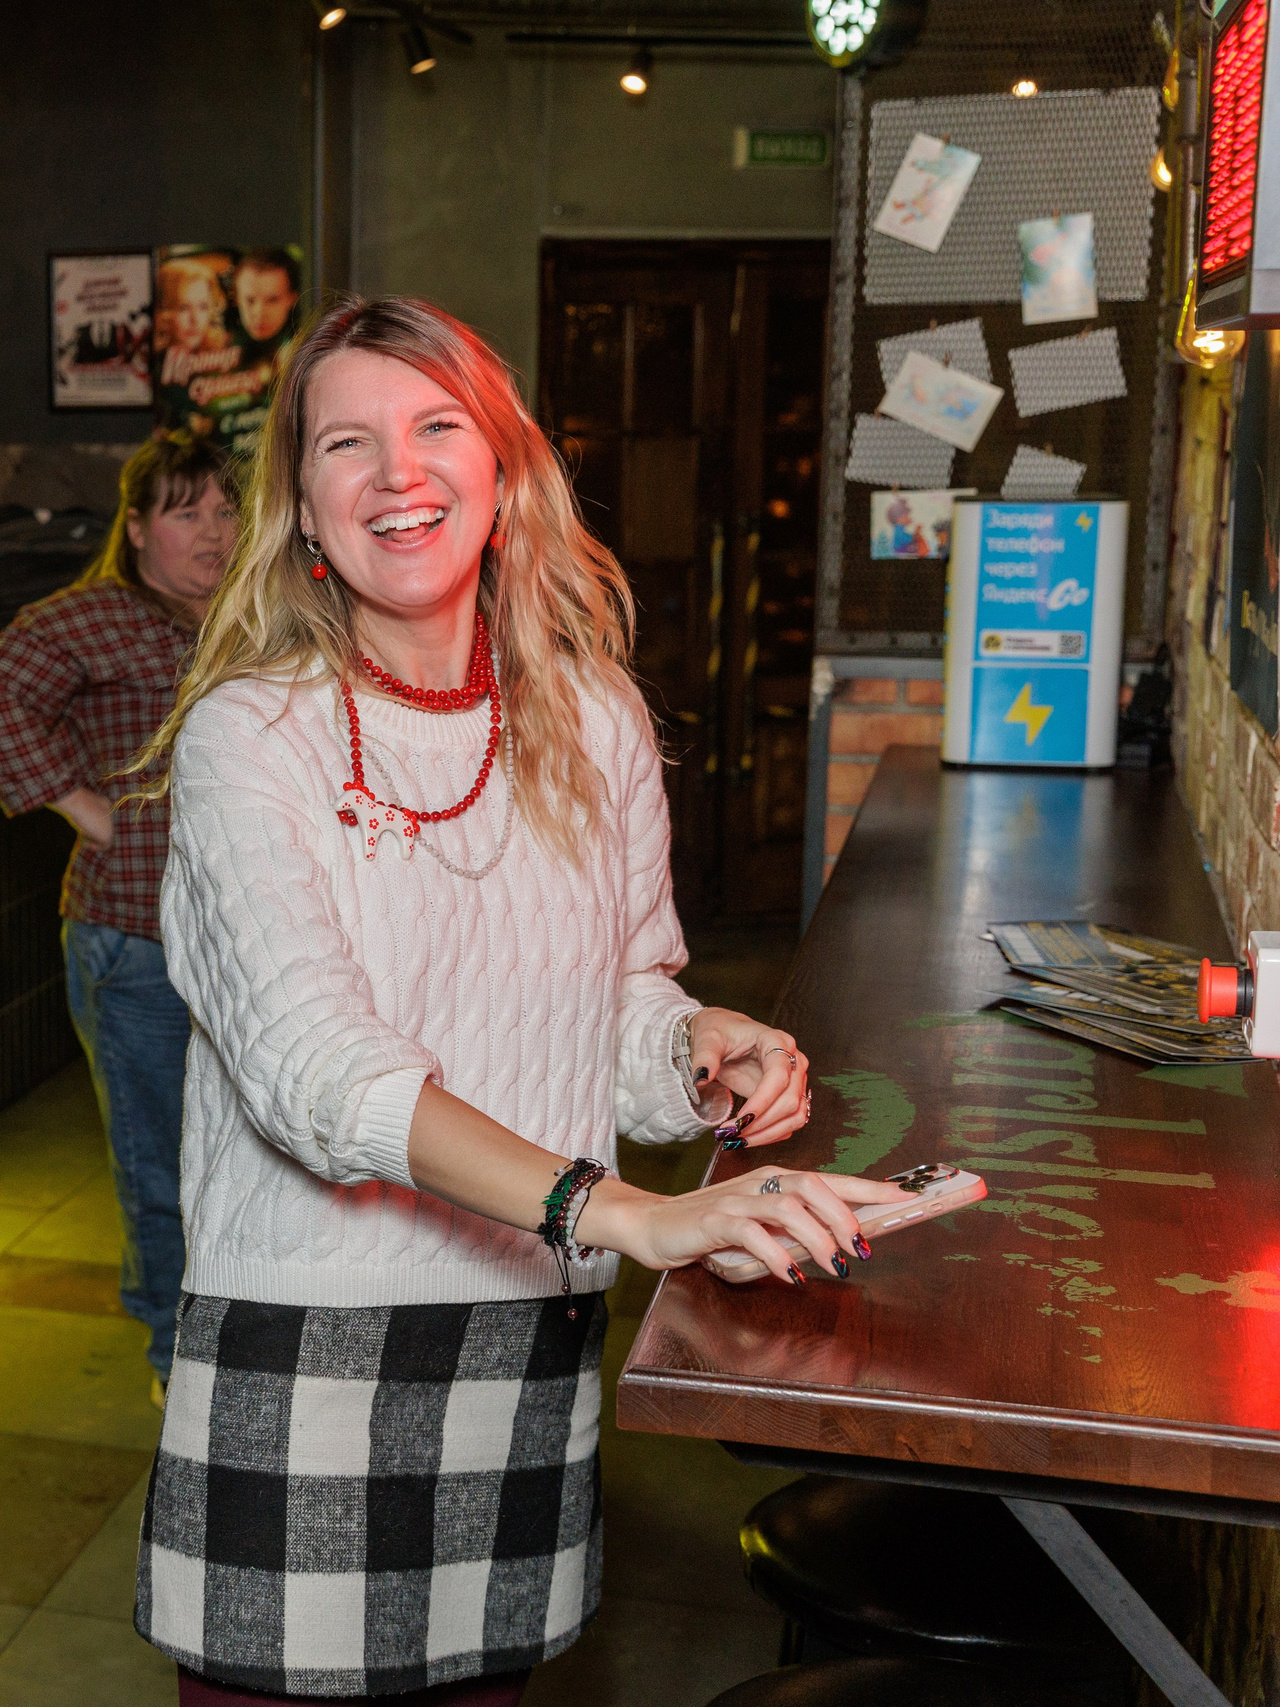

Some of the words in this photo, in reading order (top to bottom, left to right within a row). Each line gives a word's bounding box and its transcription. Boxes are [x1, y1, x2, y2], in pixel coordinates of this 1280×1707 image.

[987, 509, 1054, 530] Заряди
[986, 535, 1065, 555] телефон
[984, 562, 1038, 579] через
[982, 583, 1048, 603] Яндекс
[1047, 578, 1089, 610] Go
